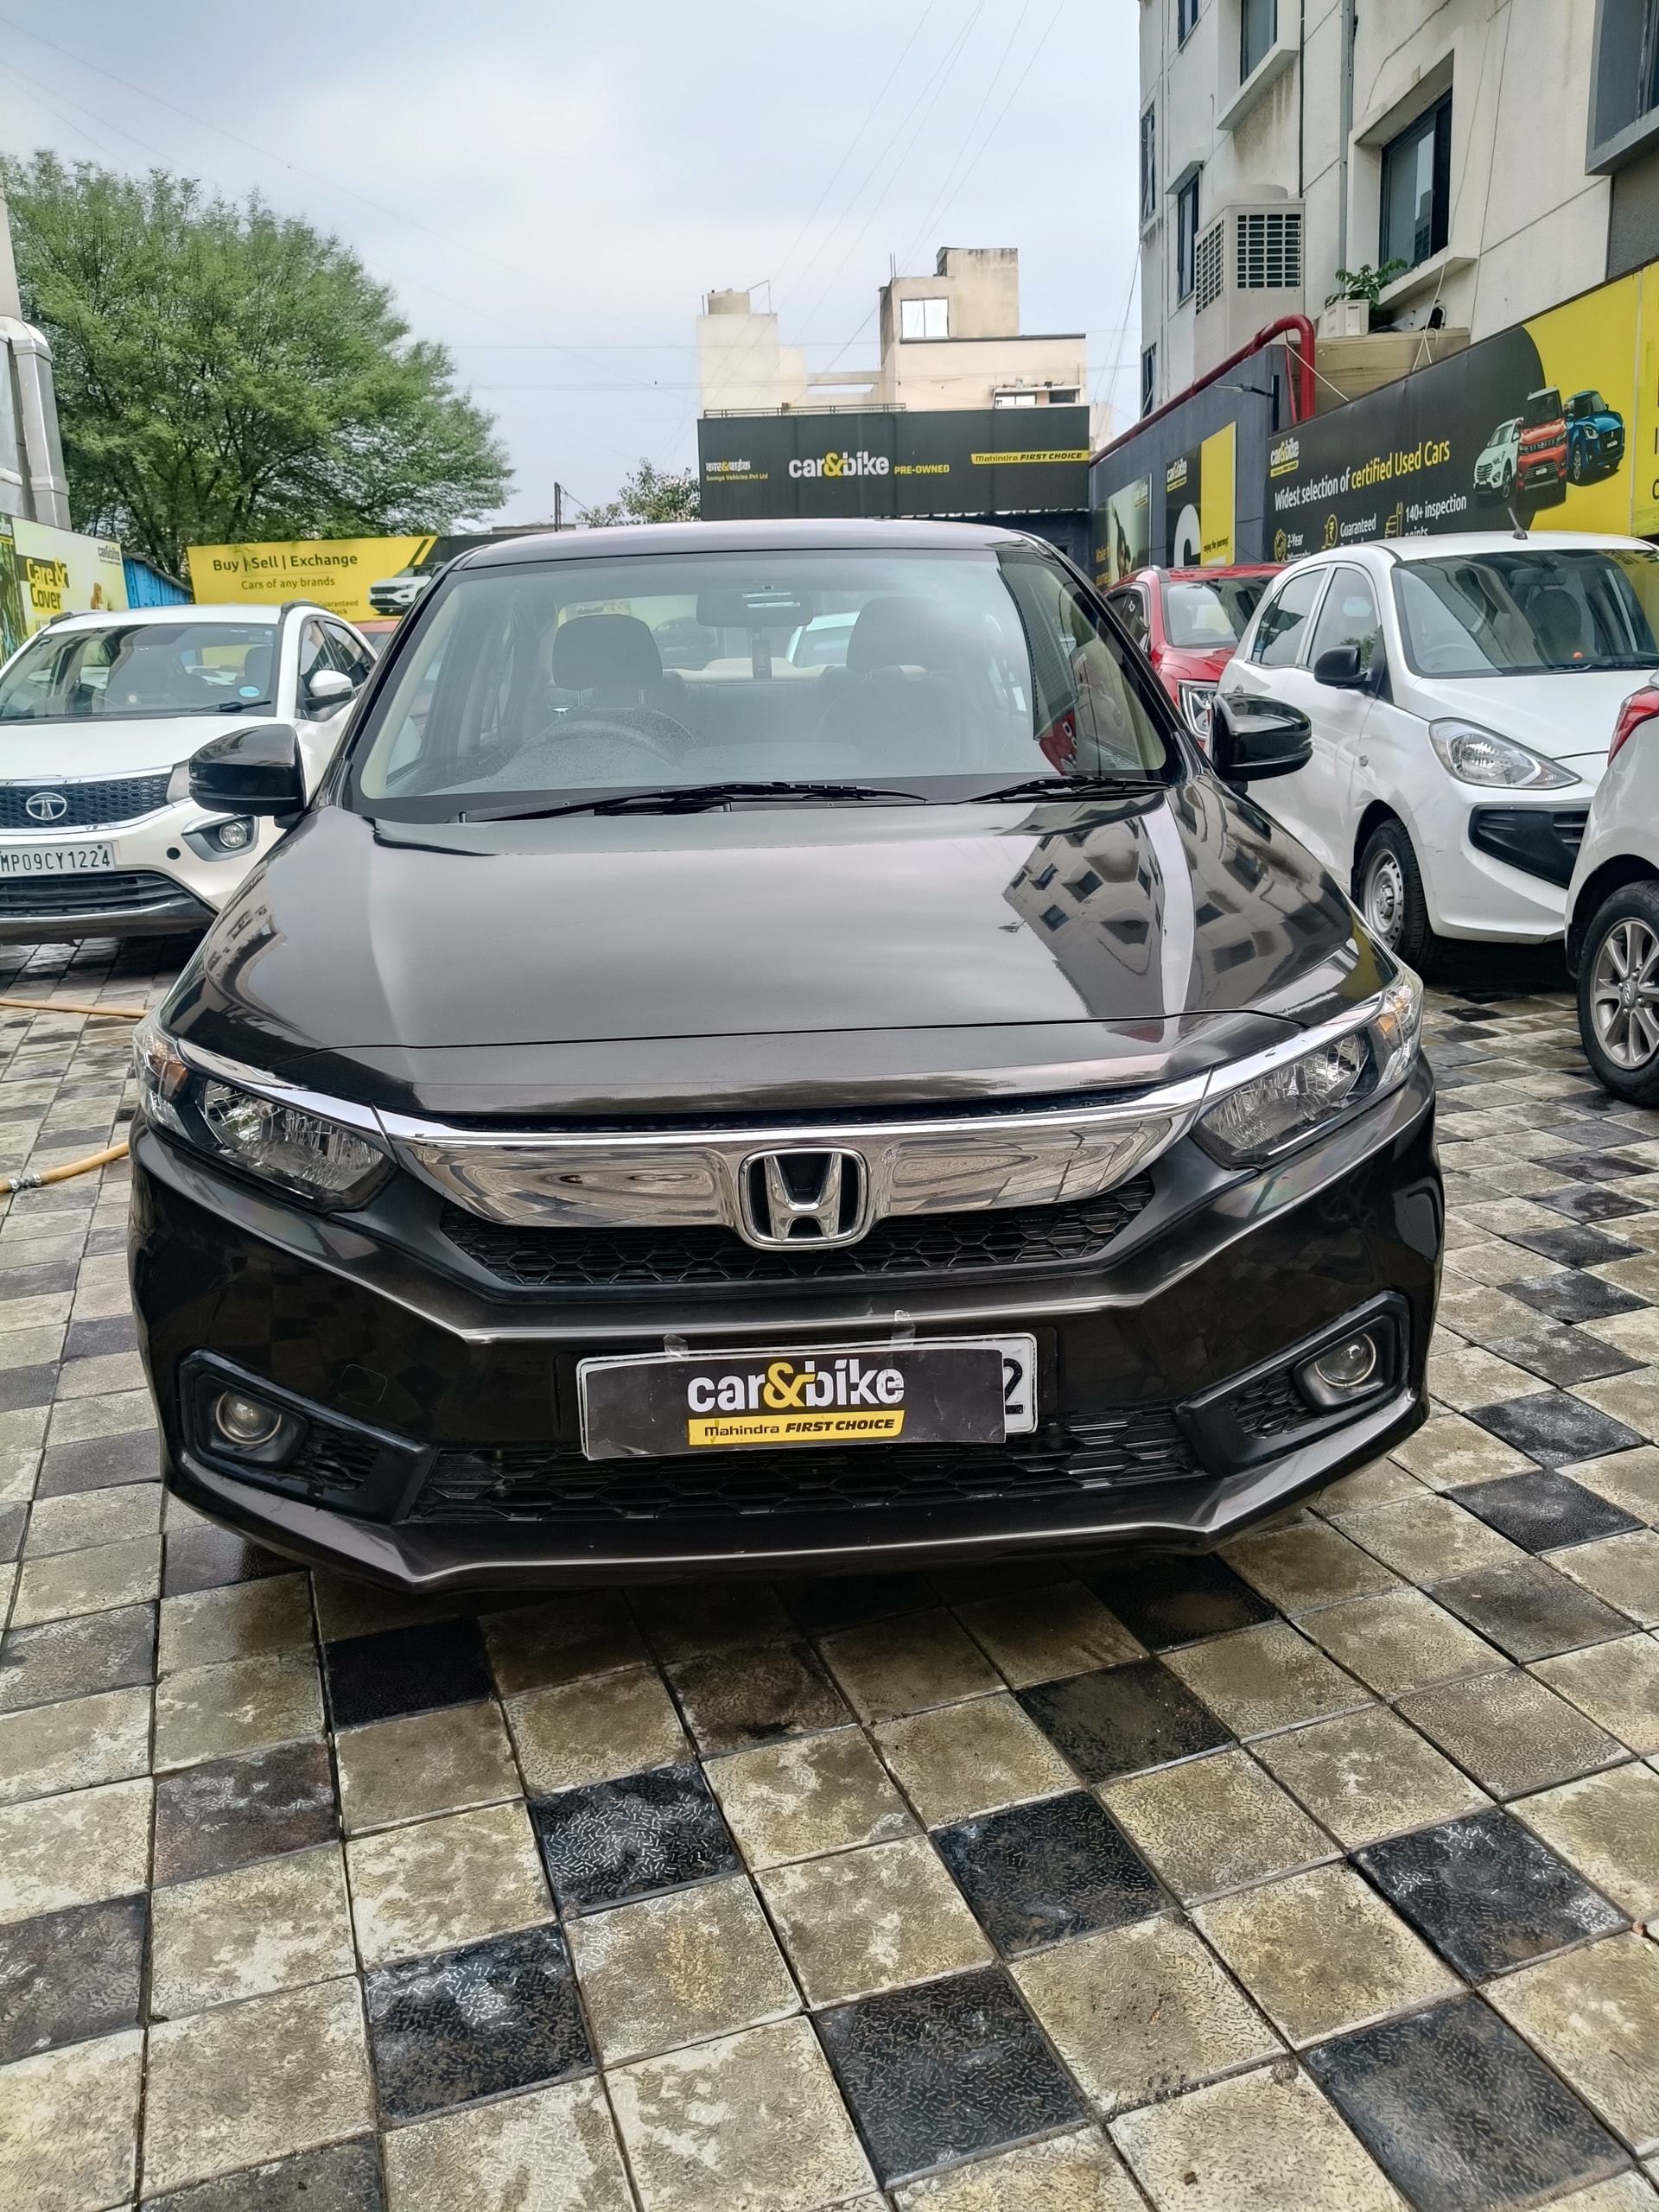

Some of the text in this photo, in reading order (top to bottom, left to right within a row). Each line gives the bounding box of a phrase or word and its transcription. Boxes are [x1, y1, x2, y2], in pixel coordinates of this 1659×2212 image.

[789, 451, 950, 478] car&bike PRE-OWNED
[1274, 440, 1451, 512] Widest selection of certified Used Cars
[1405, 493, 1467, 524] 140+ inspection
[1340, 513, 1376, 537] Guaranteed
[213, 559, 239, 571] Buy
[252, 556, 278, 569] Sell
[291, 554, 358, 568] Exchange
[242, 576, 335, 590] Cars of any brands
[30, 583, 61, 609] Cover
[0, 849, 111, 872] MP09CY1224
[687, 1359, 905, 1413] car&bike
[704, 1418, 894, 1437] Mahindra FIRST CHOICE
